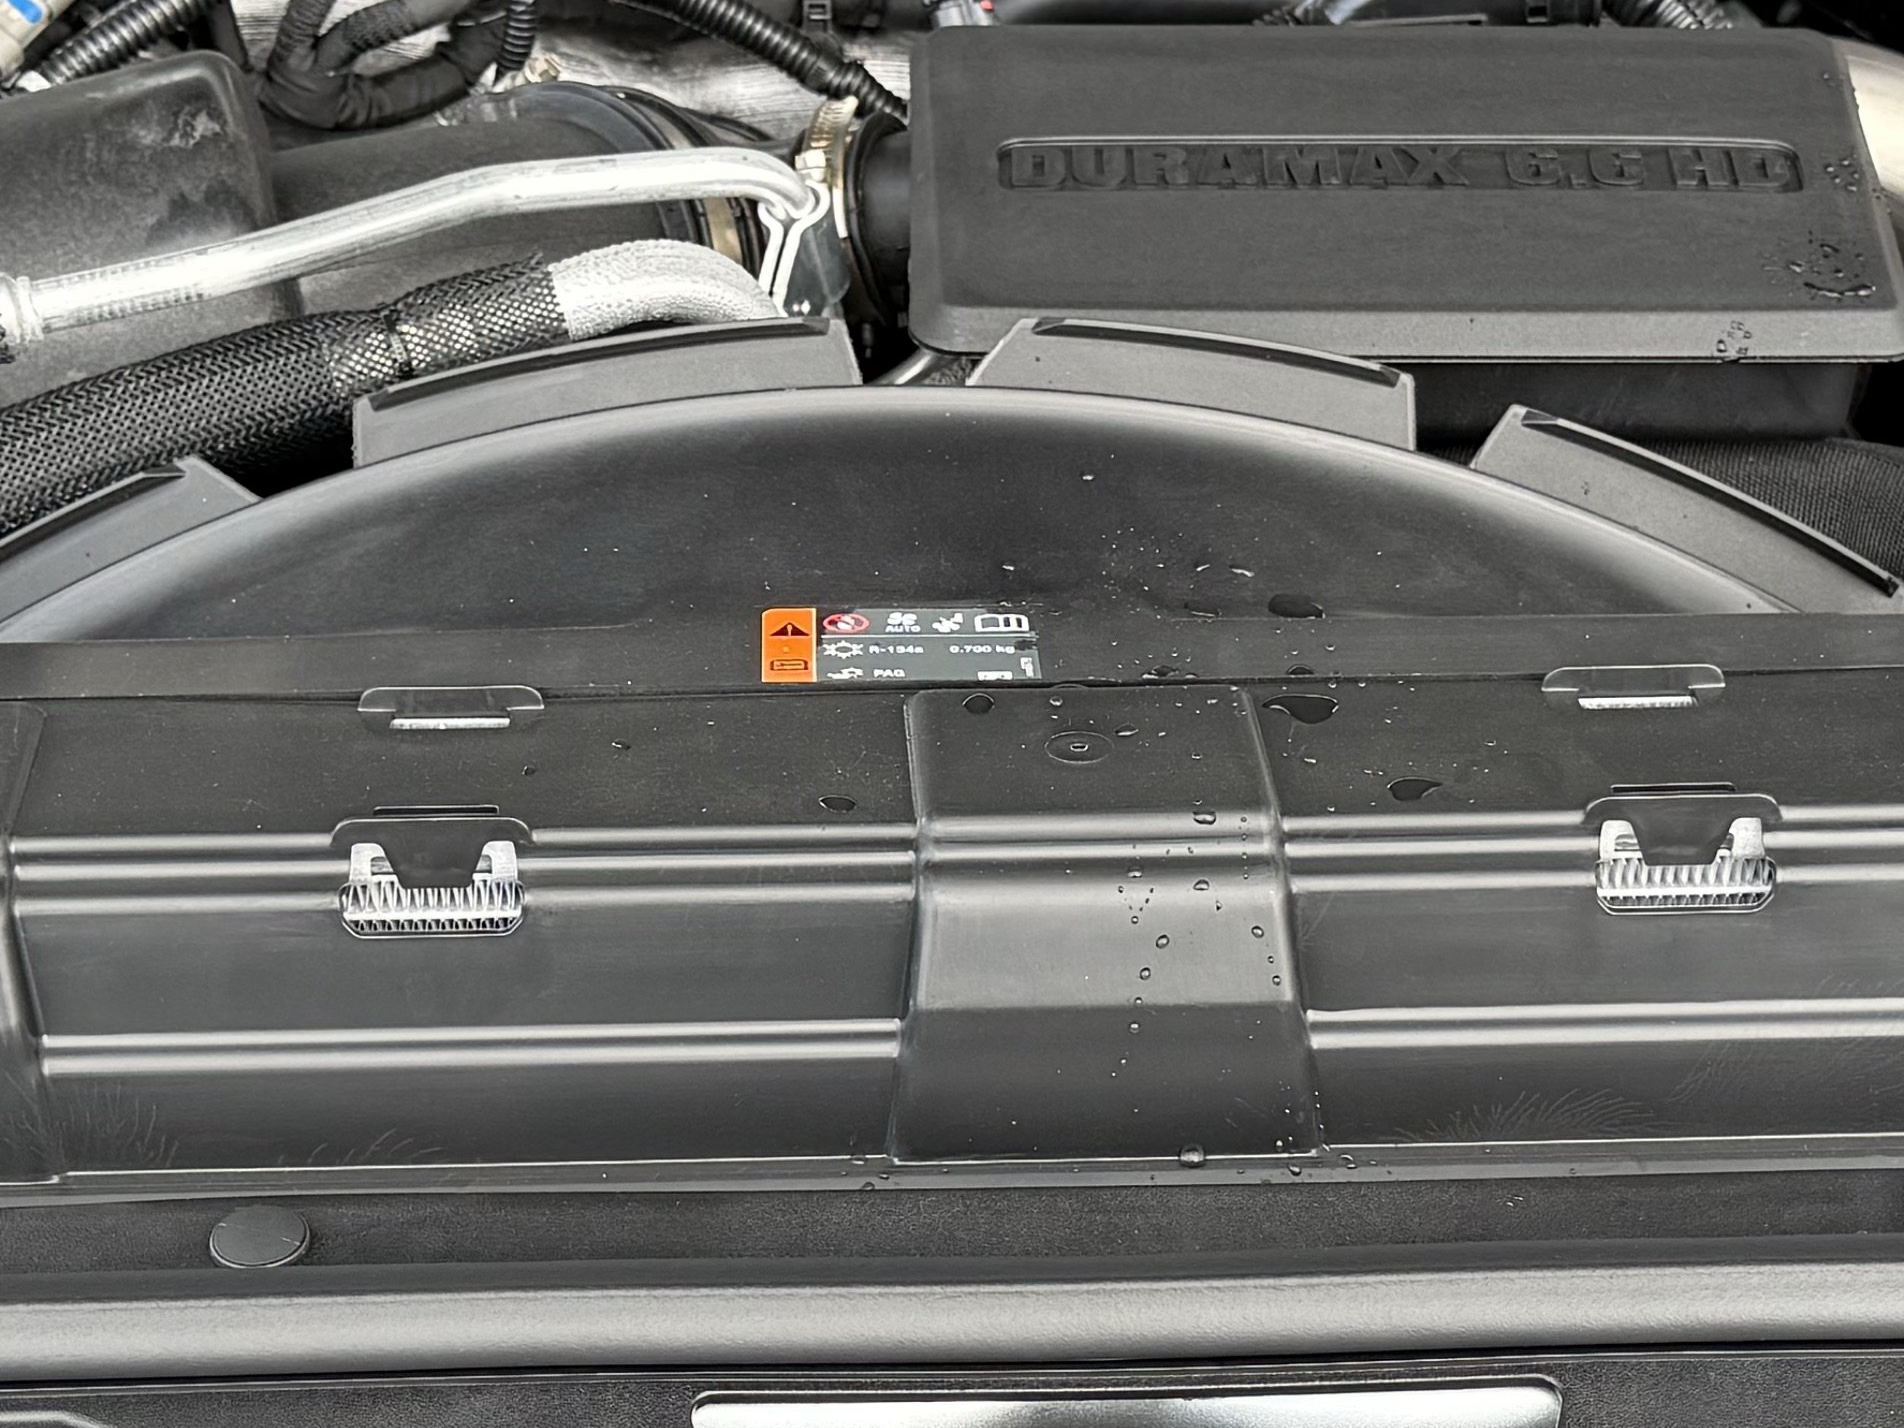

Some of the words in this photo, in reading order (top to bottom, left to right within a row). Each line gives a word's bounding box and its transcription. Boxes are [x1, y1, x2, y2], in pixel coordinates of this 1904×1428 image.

[1008, 144, 1468, 189] DURAMAX
[1504, 146, 1644, 189] 6.6
[1666, 147, 1796, 190] HD
[885, 625, 921, 633] AUTO
[950, 644, 992, 654] 0.700
